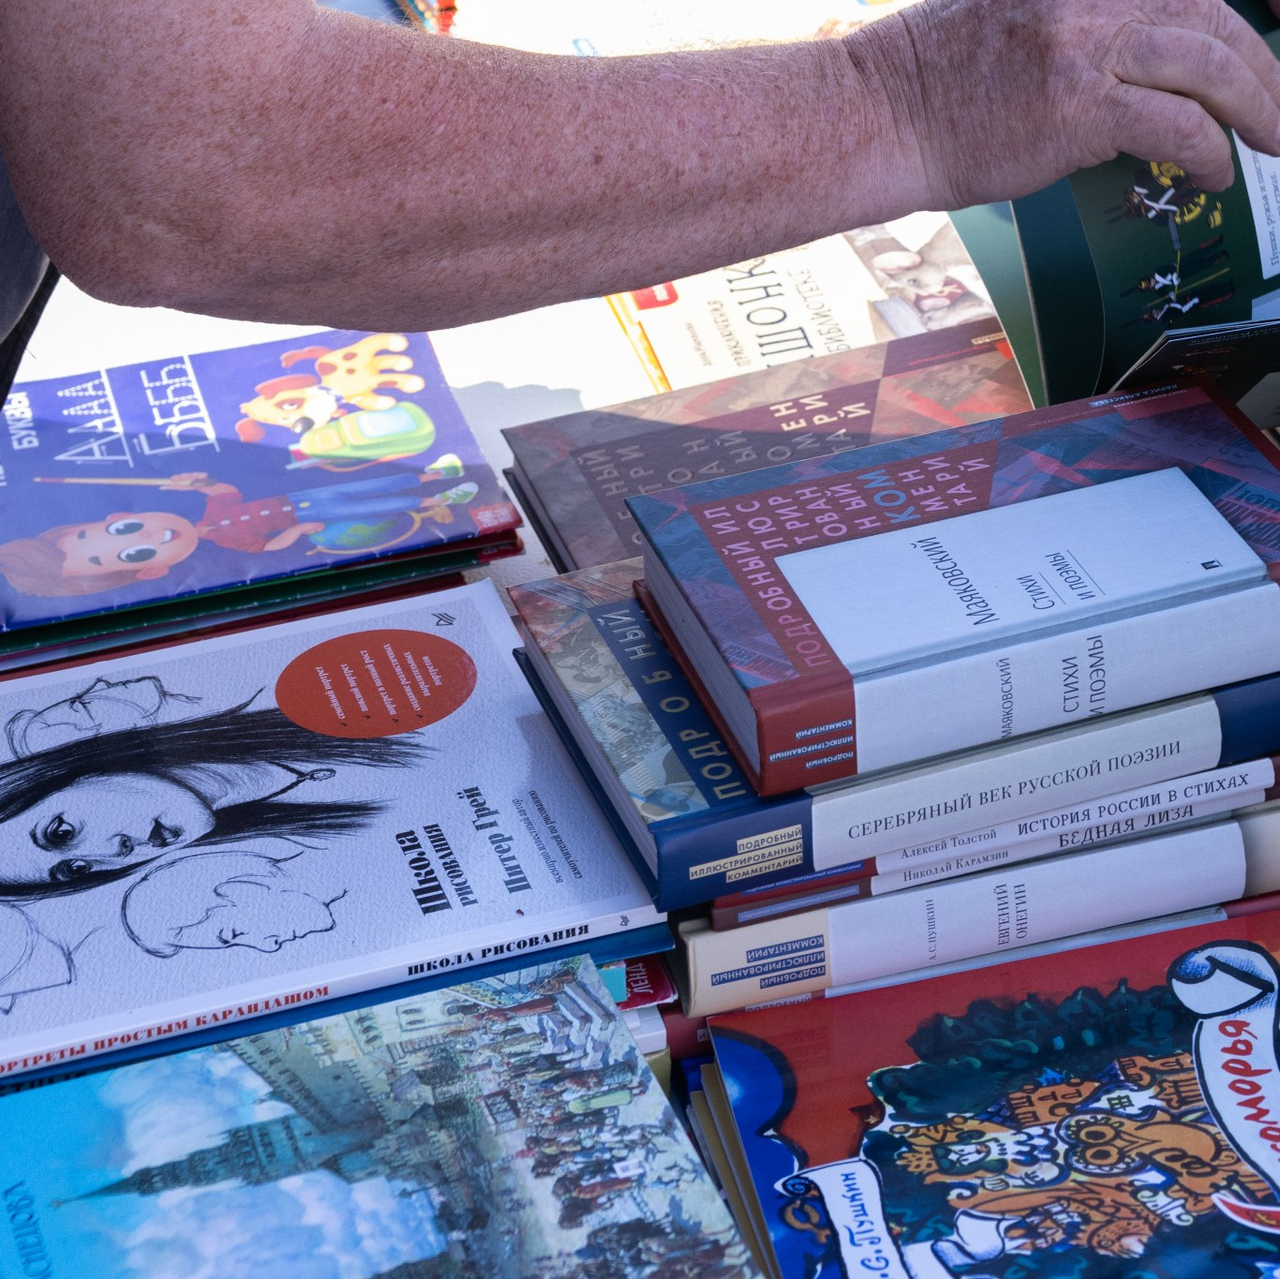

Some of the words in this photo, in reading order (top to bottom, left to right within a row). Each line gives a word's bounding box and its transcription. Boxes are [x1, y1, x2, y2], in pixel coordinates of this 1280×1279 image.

[4, 391, 39, 450] БУКВЫ
[857, 469, 921, 525] КОМ
[898, 470, 950, 514] МЕН
[722, 540, 832, 668] ПОДРОБНЫЙ
[359, 649, 375, 663] рост
[366, 662, 383, 686] полный
[383, 643, 410, 686] реалистичных
[404, 651, 431, 697] выразительных
[423, 655, 443, 686] портретов
[1087, 635, 1106, 703] ПОЭМЫ
[314, 665, 333, 689] портрет
[340, 663, 361, 686] портрет
[1061, 655, 1079, 713] СТИХИ
[325, 689, 346, 720] семейный
[350, 687, 369, 712] поясной
[378, 690, 398, 716] портрет
[403, 685, 421, 711] создание
[996, 657, 1012, 739] МАЯКОВСКИЙ
[795, 718, 853, 739] КОММЕНТАРИЙ
[769, 735, 854, 761] ИЛЛЮСТРИРОВАННЫЙ
[806, 751, 854, 769] ПОДРОБНЫЙ
[512, 798, 528, 817] автор
[848, 792, 972, 839] СЕРЕБРЯНЫЙ
[979, 785, 1012, 807] ВЕК
[1018, 758, 1102, 800] РУССКОЙ
[1108, 740, 1182, 772] ПОЭЗИИ
[1017, 808, 1092, 837] ИСТОРИЯ
[1098, 791, 1161, 819] РОССИИ
[1168, 788, 1178, 802] В
[1183, 772, 1250, 798] СТИХАХ
[456, 786, 500, 832] Грей
[528, 790, 557, 826] рисованию
[520, 817, 547, 852] известный
[738, 827, 803, 852] ПОДРОБНЫЙ
[1058, 818, 1136, 849] БЕДНАЯ
[1143, 804, 1194, 829] ЛИЗА
[395, 829, 454, 917] Школа
[488, 831, 533, 895] Питер
[541, 850, 563, 884] всемирно
[549, 834, 583, 879] самоучителей
[690, 842, 803, 878] ИЛЛЮСТРИРОВАННЫЙ
[727, 855, 803, 882] КОММЕНТАРИЙ
[926, 899, 936, 942] ПУШКИН
[993, 883, 1010, 946] ЕВГЕНИЙ
[1014, 883, 1028, 939] ОНЕГИН
[407, 950, 475, 976] ШКОЛА
[481, 924, 590, 961] РИСОВАНИЯ
[747, 935, 824, 962] КОММЕНТАРИЙ
[627, 963, 653, 993] ЛЕНД
[712, 951, 826, 985] ИЛЛЮСТРИРОВАННЫЙ
[761, 966, 826, 988] ПОДРОБНЫЙ
[94, 1018, 189, 1052] ПРОСТЫМ
[196, 985, 330, 1027] КАРАНДАШОМ
